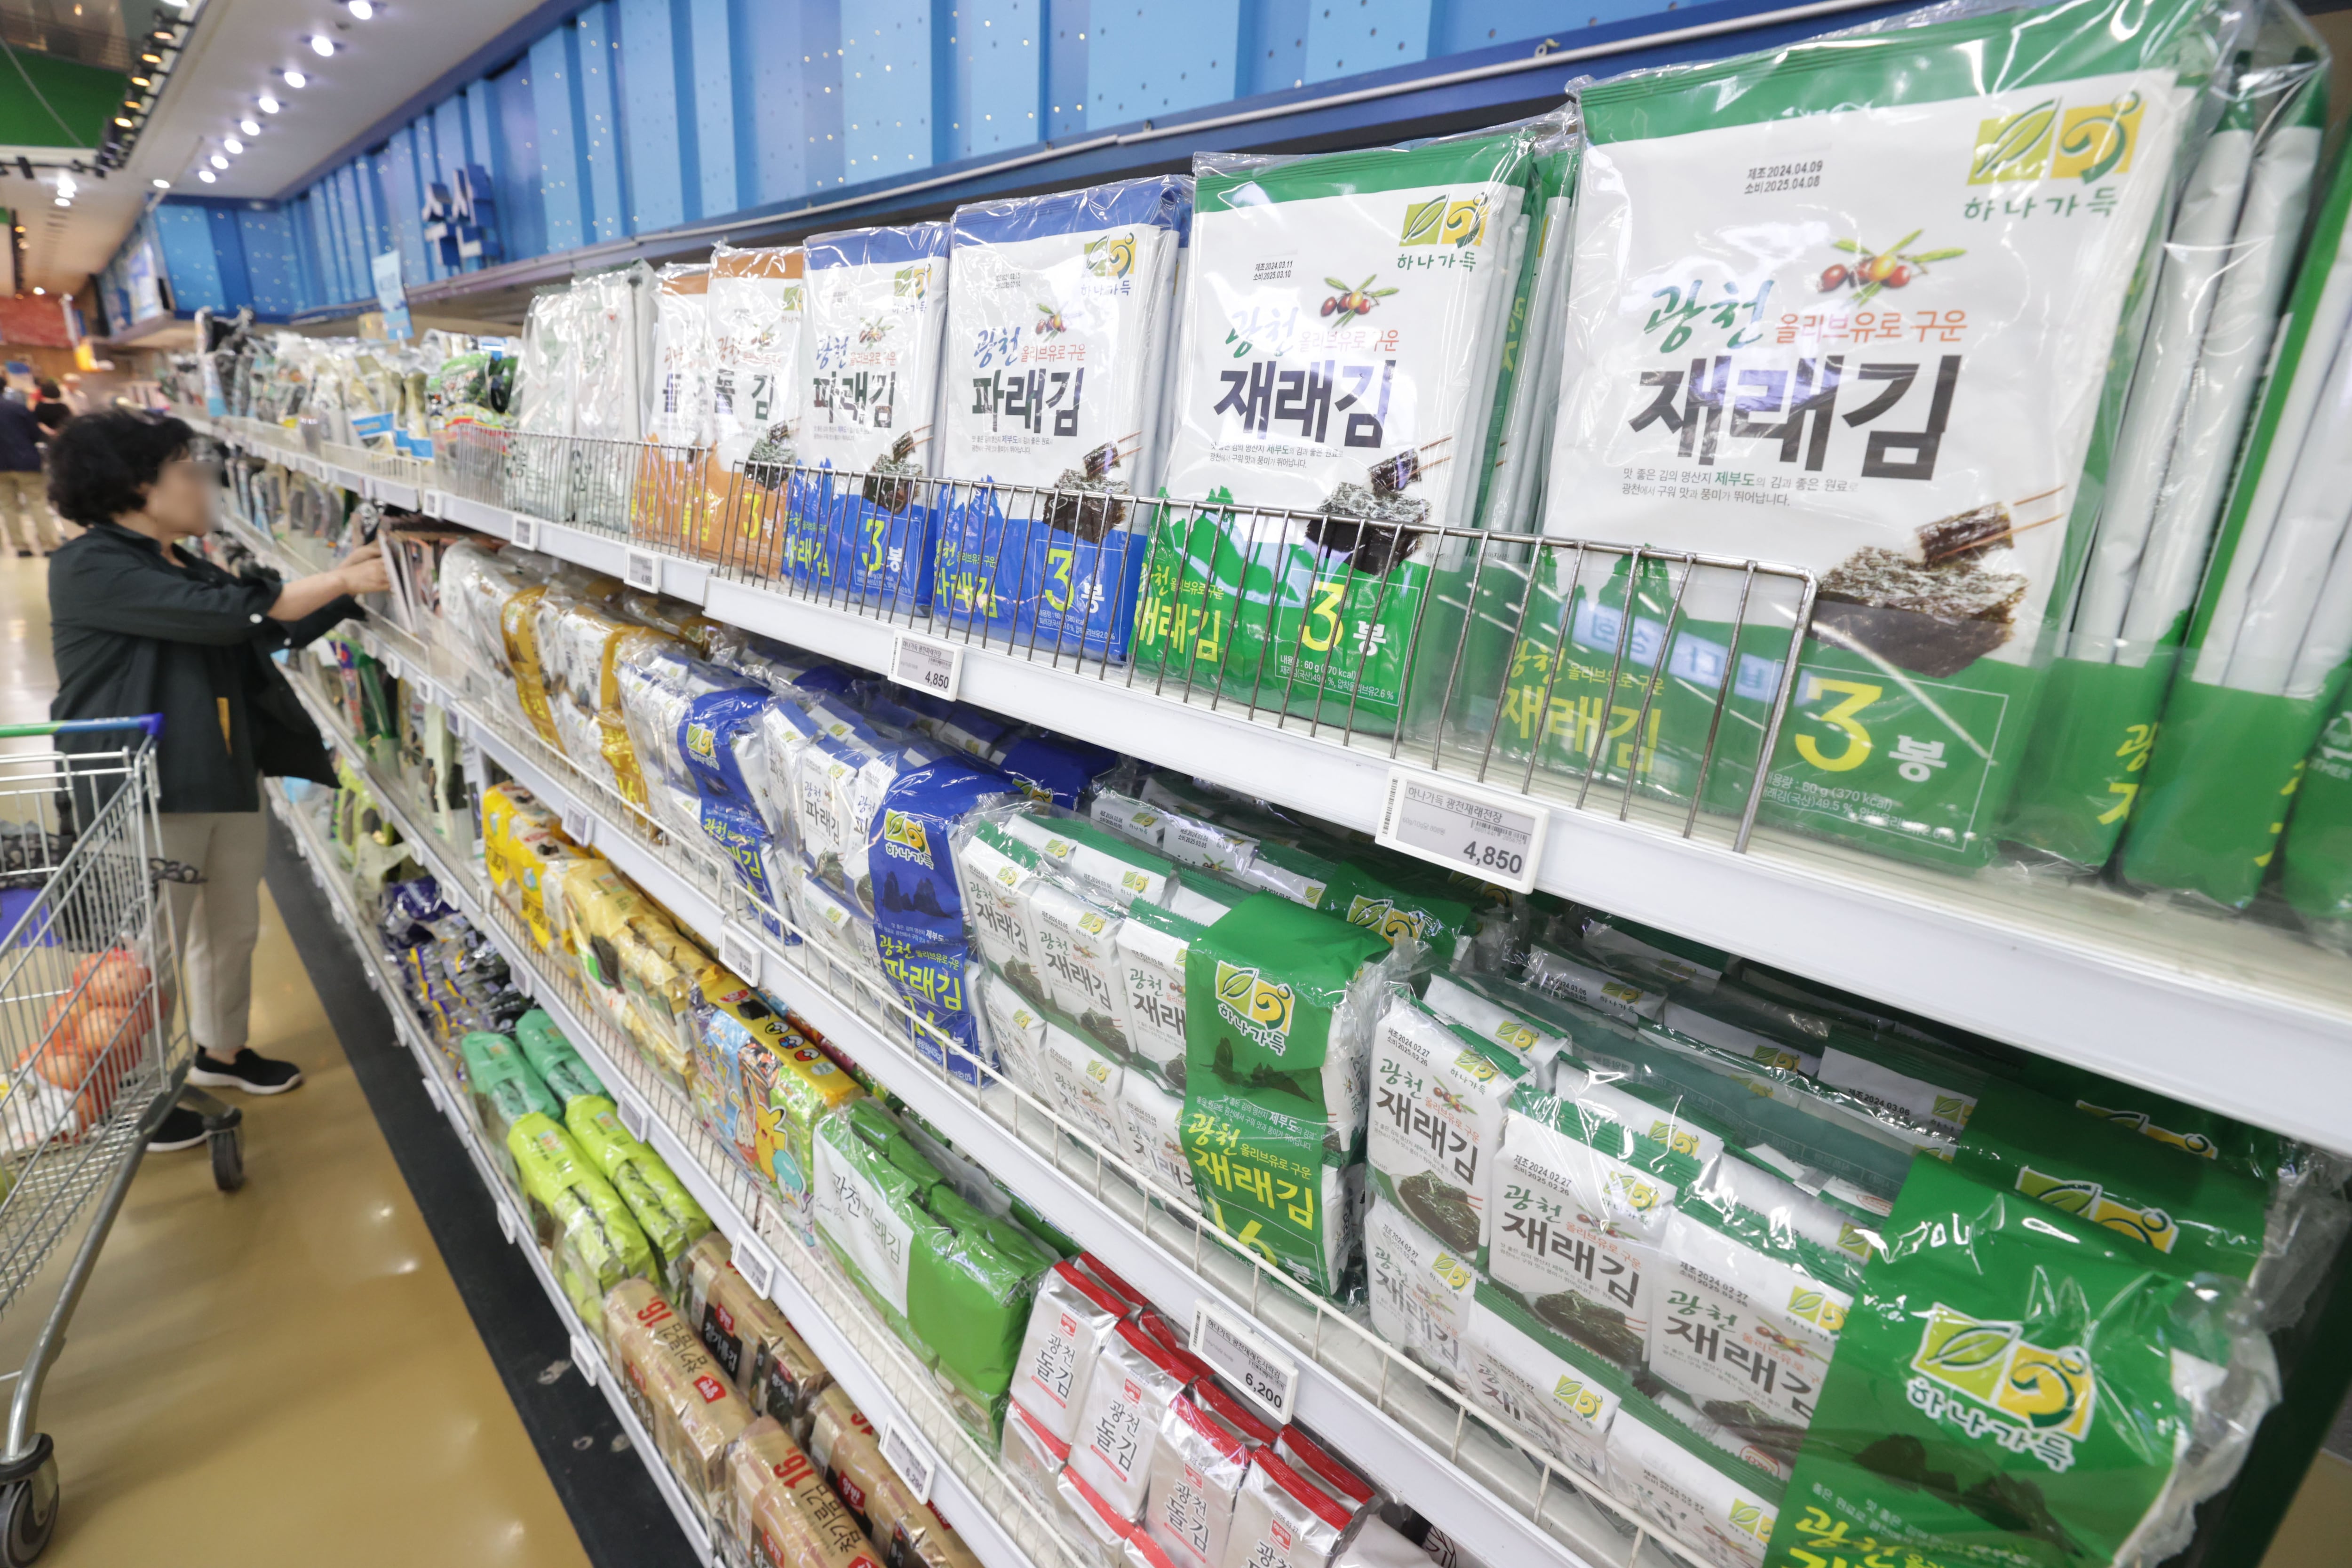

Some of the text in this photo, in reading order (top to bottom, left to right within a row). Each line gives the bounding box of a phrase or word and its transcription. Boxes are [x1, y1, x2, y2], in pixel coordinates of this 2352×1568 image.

[1964, 187, 2117, 221] 하나가득
[1397, 251, 1477, 271] 하나가득
[1644, 279, 1773, 352] 광천
[1775, 309, 1968, 344] 올리브유로 구운
[974, 326, 1021, 368] 광천
[1021, 343, 1087, 363] 올리브유로 구운
[813, 371, 896, 428] 파래김
[972, 367, 1084, 437] 파래김
[1213, 359, 1396, 448] 재래김
[1628, 354, 1963, 481] 재래김
[1621, 483, 1790, 507] 광천에서 구워 맛과 풍미가 뛰어납니다.
[1623, 468, 1632, 480] 맛
[1636, 469, 1656, 481] 좋은
[1659, 469, 1677, 483] 김의
[1681, 470, 1711, 485] 명산지
[1714, 470, 1765, 489] 제부도의
[1770, 475, 1791, 490] 김과
[1795, 477, 1819, 493] 좋은
[925, 671, 949, 689] 4,850
[805, 799, 840, 847] 파래김
[1408, 787, 1503, 824] 하나가득 광천재래전장
[885, 843, 934, 869] 하나가득
[1463, 841, 1523, 874] 4,850
[969, 881, 994, 901] 광천
[880, 934, 914, 960] 광천
[977, 902, 1029, 956] 재래김
[1040, 931, 1071, 956] 광천
[882, 958, 961, 1011] 파래김
[1047, 953, 1112, 1011] 재래김
[1129, 967, 1163, 996] 광천
[1218, 1002, 1286, 1056] 하나가득
[1380, 1058, 1423, 1099] 광천
[1450, 1067, 1486, 1095] 하나가득
[1241, 1102, 1251, 1112] 김의
[1253, 1107, 1268, 1119] 명산지
[1245, 1116, 1255, 1126] 구워
[1188, 1114, 1240, 1156] 광천
[1376, 1086, 1478, 1186] 재래김
[1240, 1143, 1312, 1180] 올리브유로 구운
[1191, 1147, 1313, 1231] 재래김
[1504, 1184, 1562, 1225] 광천
[1502, 1211, 1640, 1309] 재래김
[1566, 1221, 1642, 1271] 올리브유로 구운
[1667, 1289, 1739, 1334] 광천
[1048, 1332, 1076, 1369] 광천
[1245, 1372, 1282, 1409] 6,200
[1109, 1400, 1140, 1436] 광천
[1907, 1377, 2075, 1473] 하나가득
[1174, 1480, 1208, 1520] 광천
